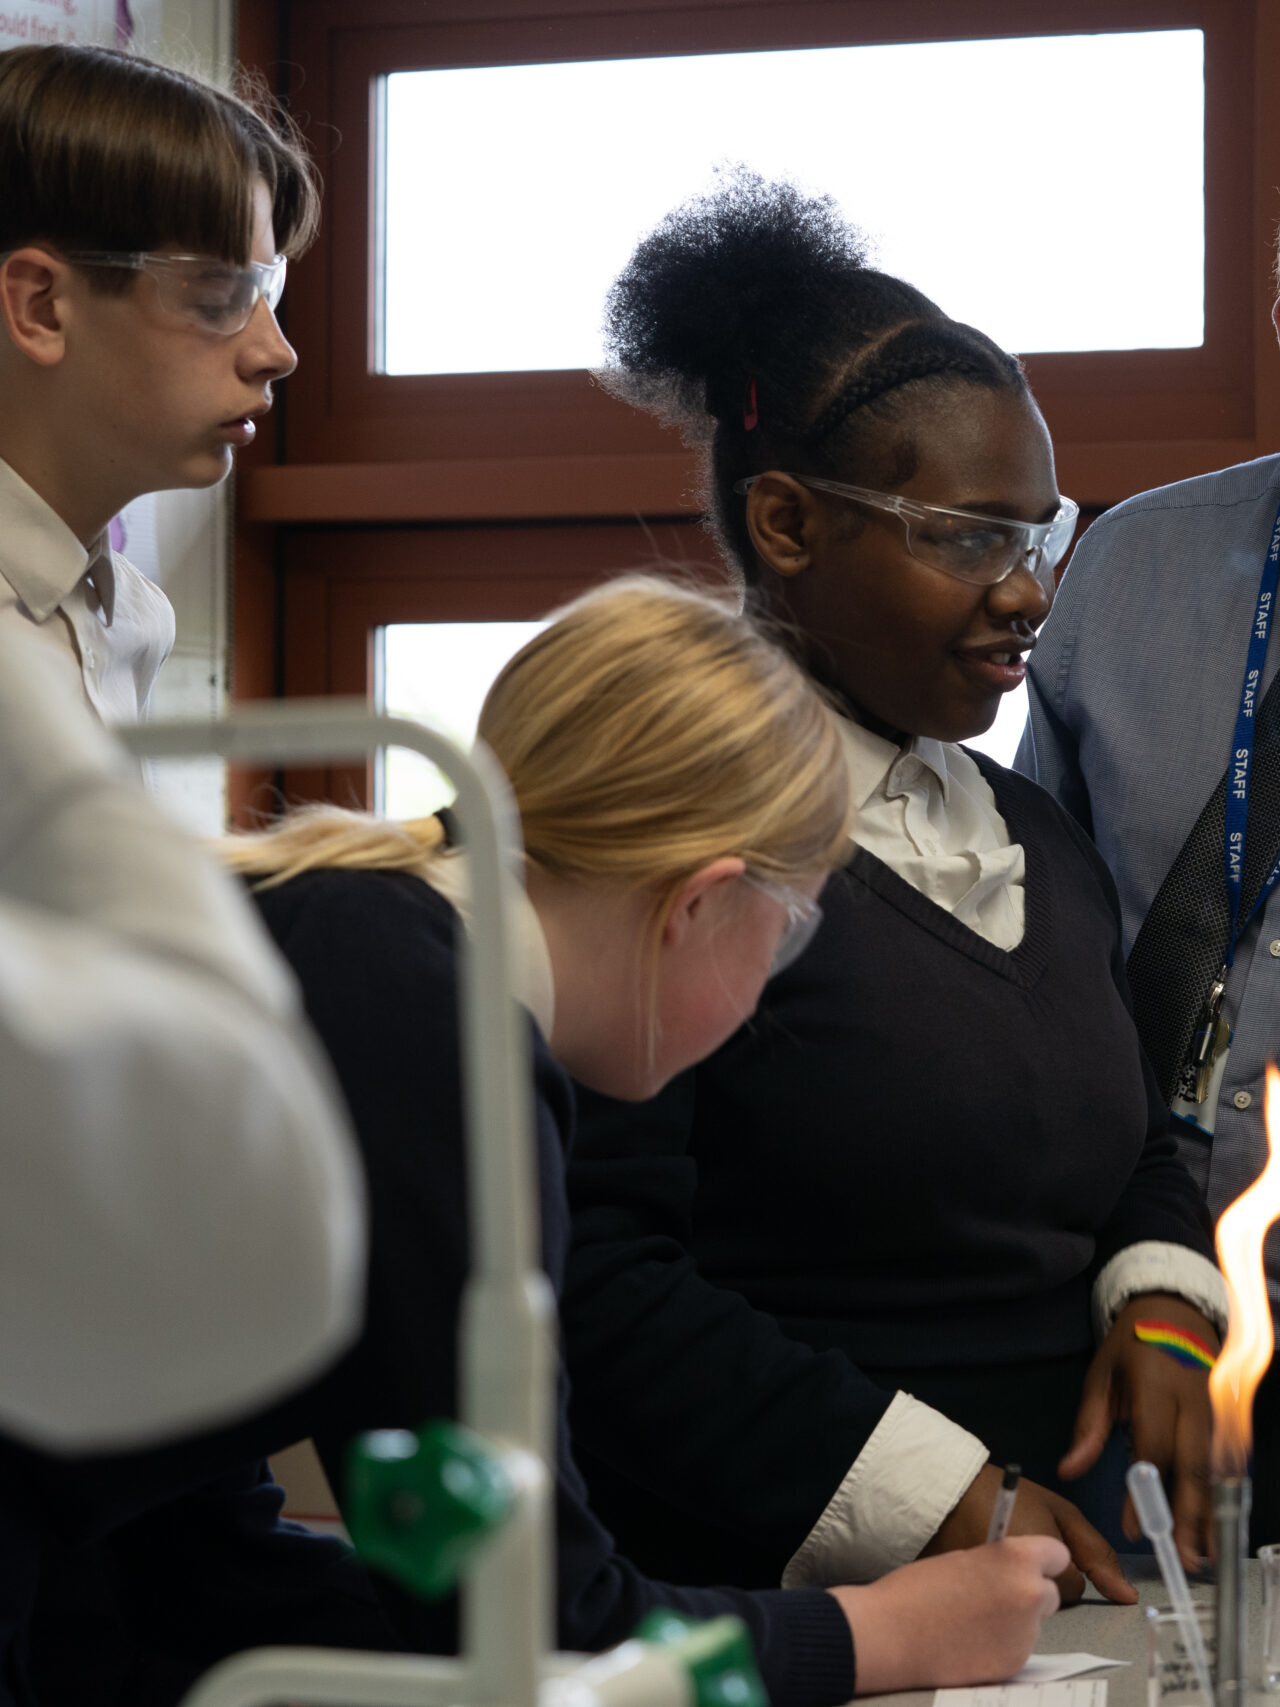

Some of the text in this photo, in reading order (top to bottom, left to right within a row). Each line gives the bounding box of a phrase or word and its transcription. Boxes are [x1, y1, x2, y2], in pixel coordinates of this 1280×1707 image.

[1255, 592, 1272, 639] STAFF
[1243, 669, 1259, 718] STAFF
[1233, 748, 1249, 800] STAFF
[1229, 832, 1243, 884] STAFF
